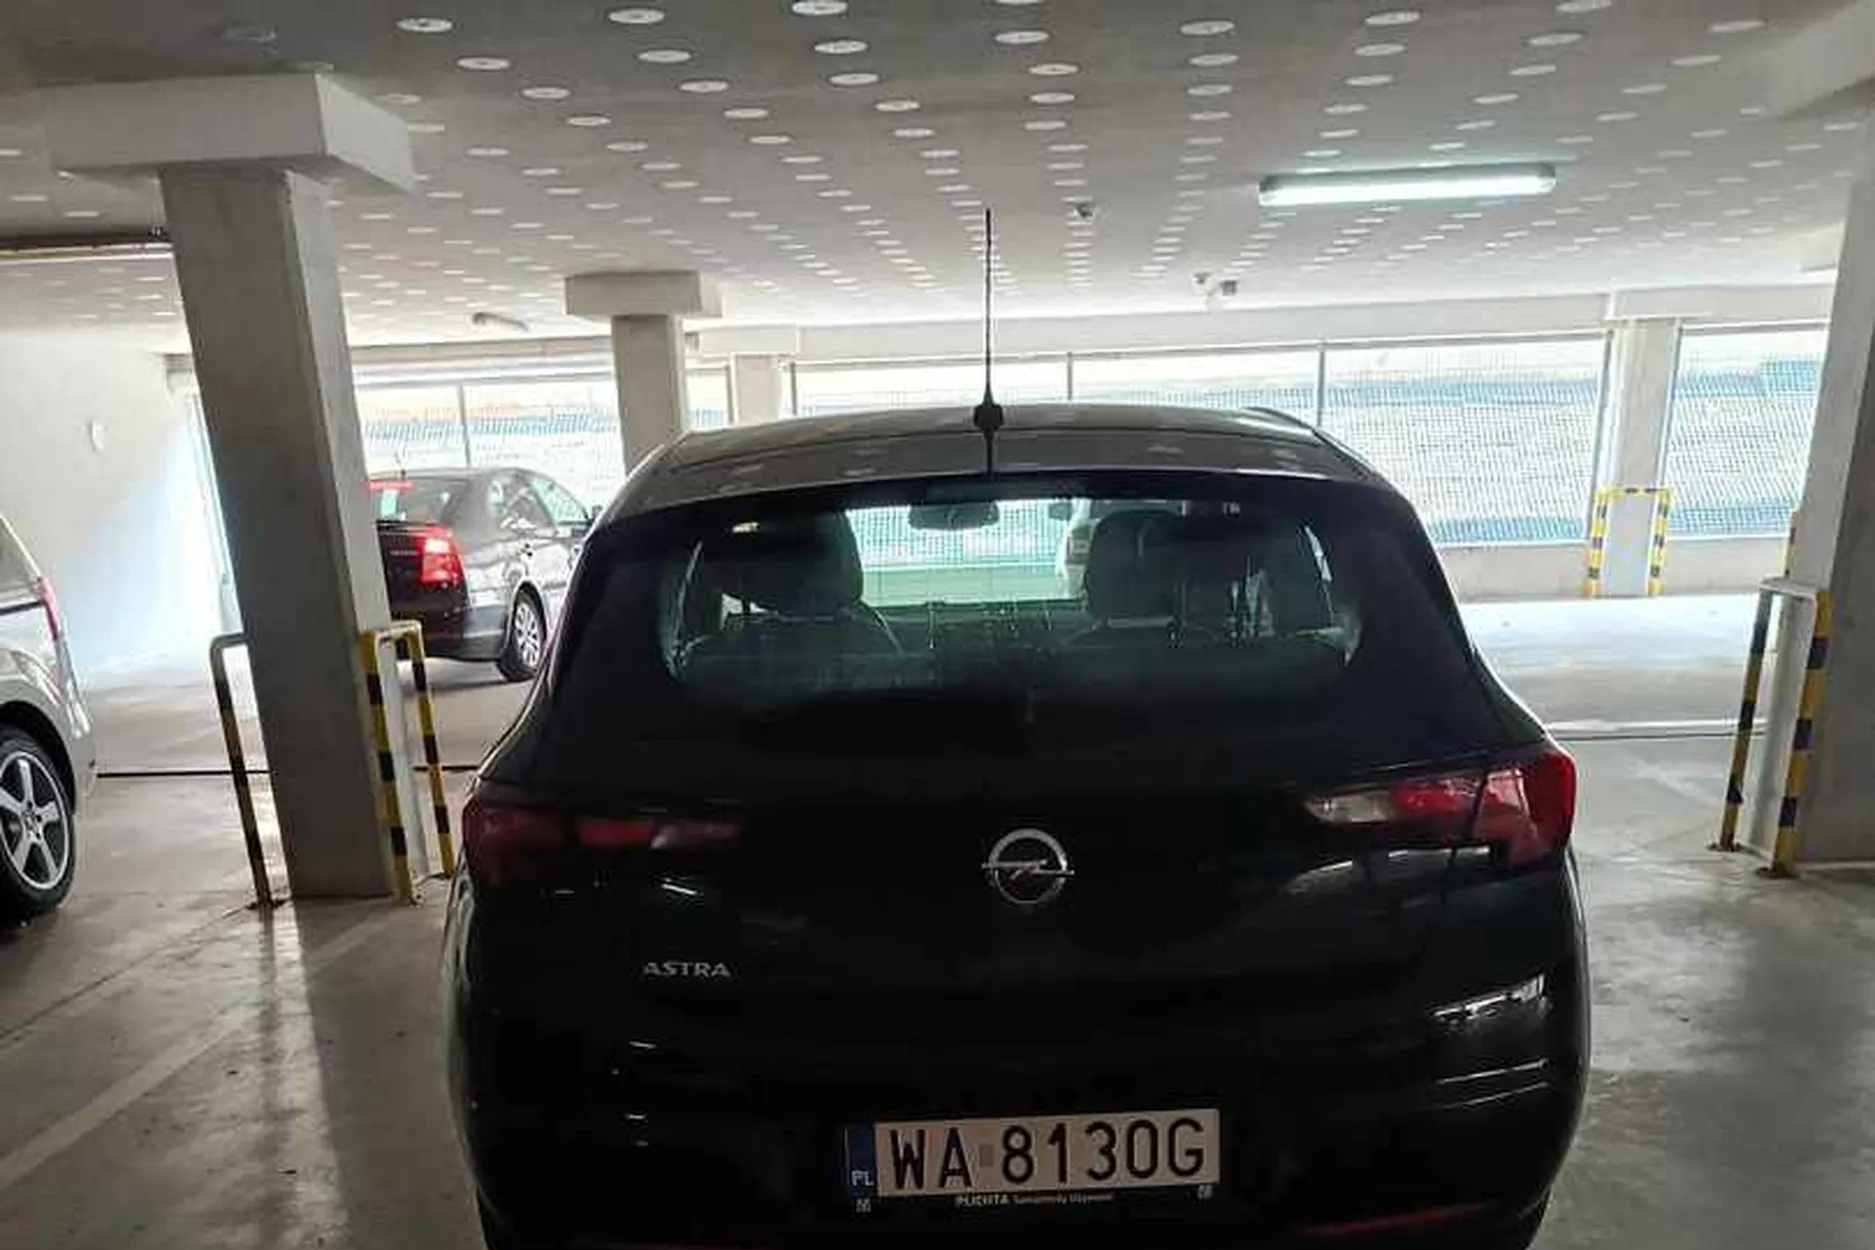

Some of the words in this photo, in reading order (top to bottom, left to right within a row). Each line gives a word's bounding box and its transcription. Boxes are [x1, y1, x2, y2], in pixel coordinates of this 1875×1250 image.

[643, 961, 731, 977] ASTRA
[889, 1126, 972, 1189] WA
[1001, 1117, 1205, 1185] 8130G
[852, 1170, 875, 1187] PL
